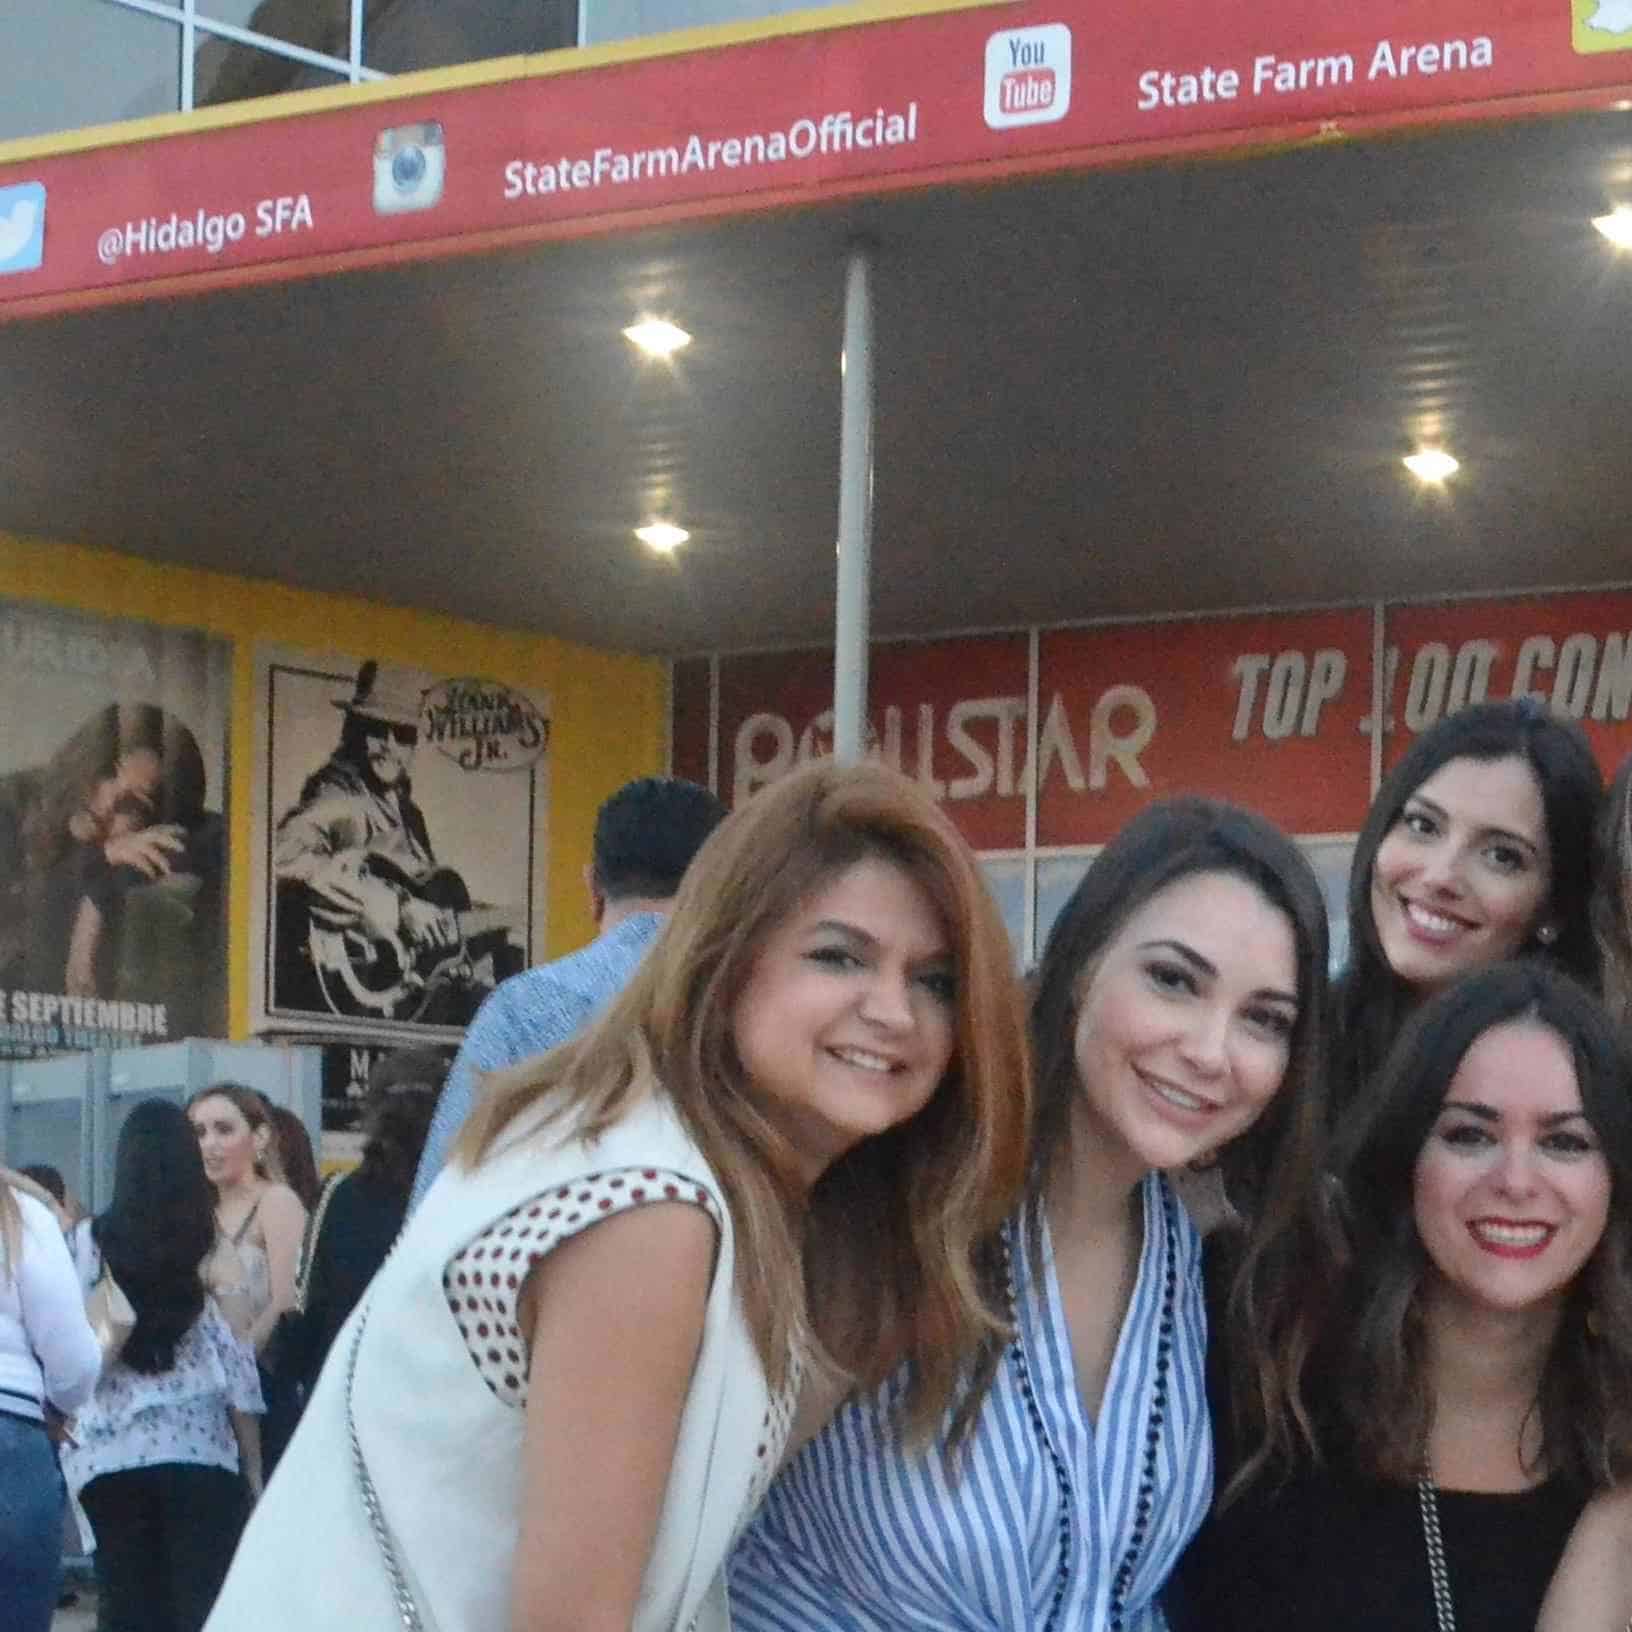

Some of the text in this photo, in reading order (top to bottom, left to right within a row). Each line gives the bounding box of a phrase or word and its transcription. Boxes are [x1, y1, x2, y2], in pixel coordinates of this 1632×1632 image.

[1008, 37, 1046, 67] You
[1137, 36, 1494, 111] State Farm Arena
[1001, 71, 1054, 110] Tube
[504, 102, 918, 199] StateFarmArenaOfficial
[98, 194, 314, 265] @Hidalgo SFA
[1232, 649, 1347, 741] TOP
[12, 989, 168, 1036] SEPTIEMBRE
